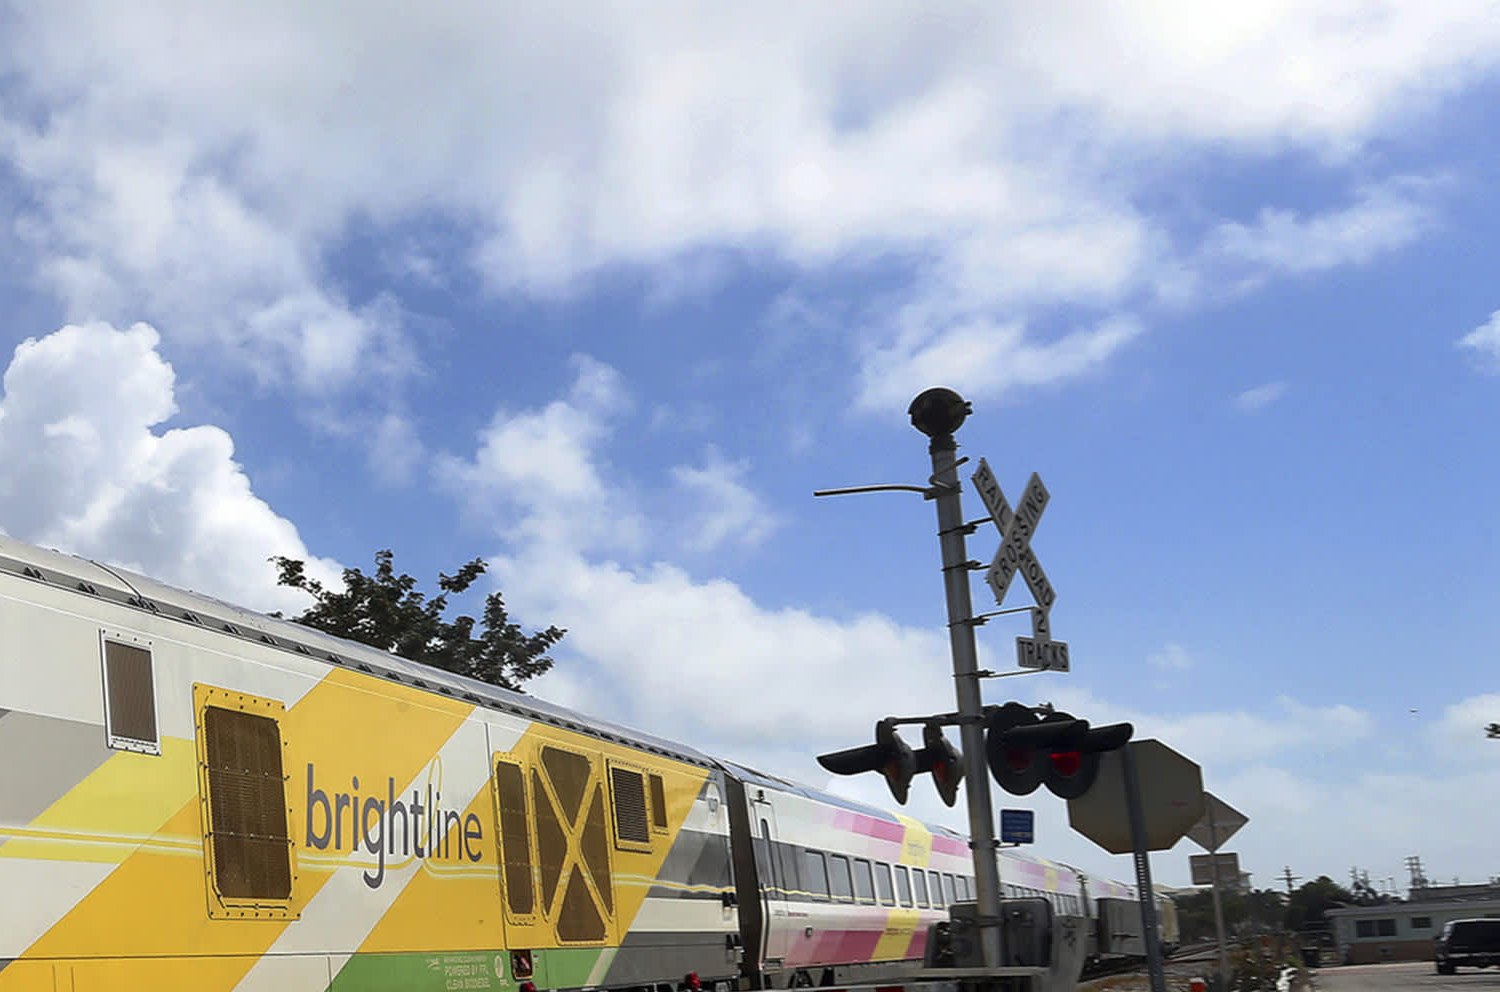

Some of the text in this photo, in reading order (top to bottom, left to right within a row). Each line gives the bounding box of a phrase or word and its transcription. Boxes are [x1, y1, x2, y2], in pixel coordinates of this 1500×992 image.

[978, 467, 1007, 526] RAIL
[993, 485, 1045, 590] CROSSING
[1036, 609, 1046, 633] 2
[1019, 641, 1068, 668] TRACKS
[306, 763, 483, 889] brightline
